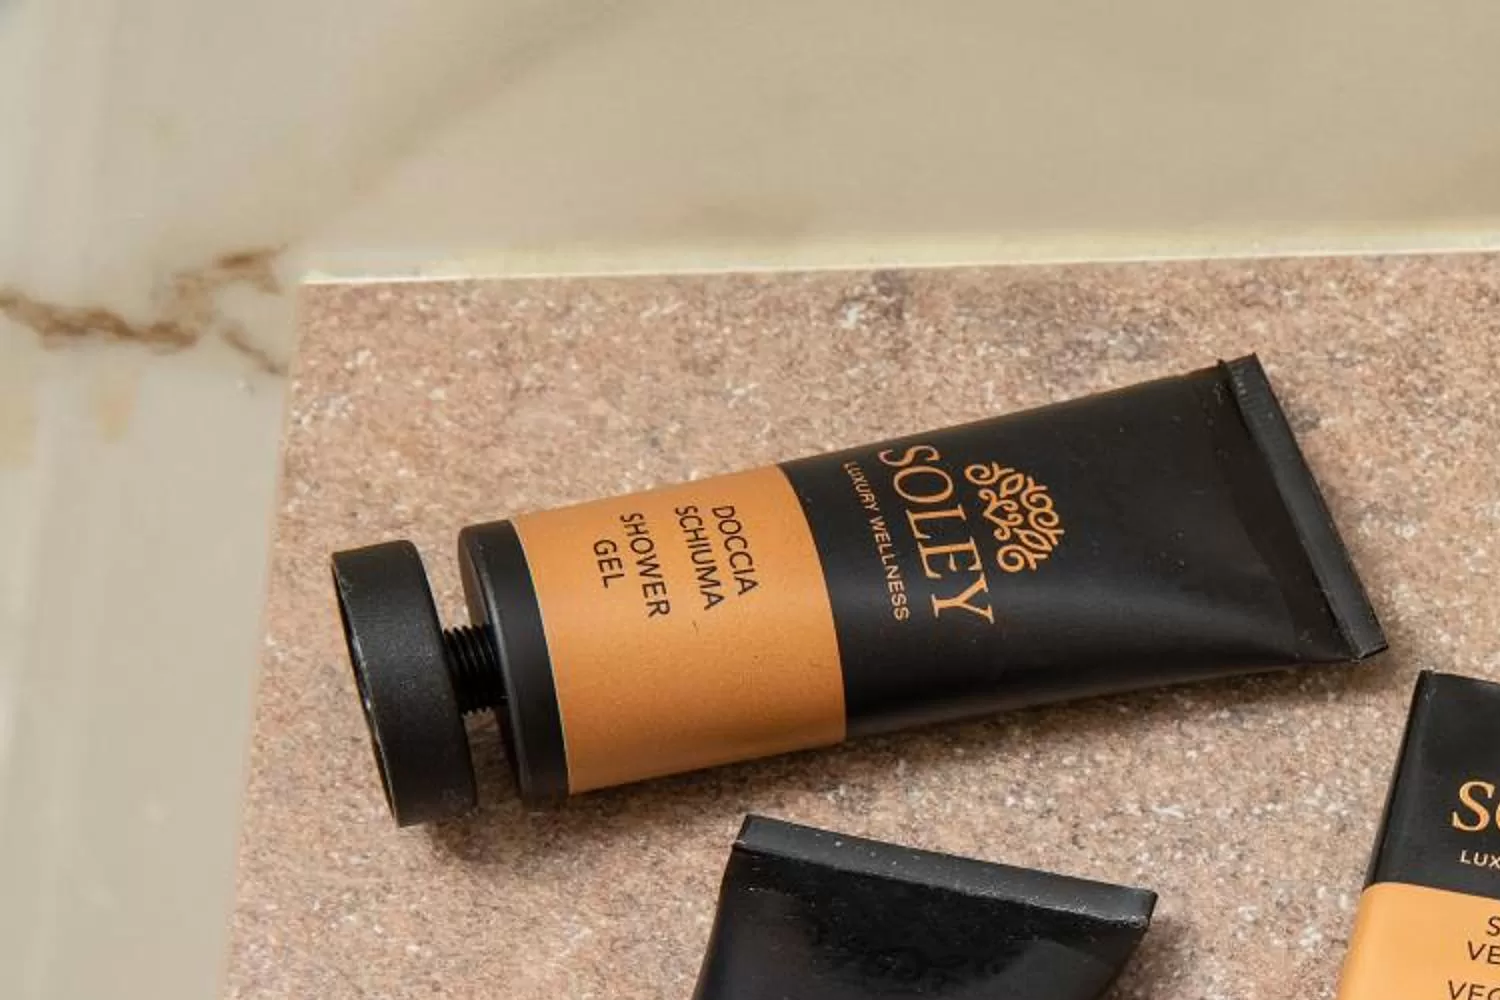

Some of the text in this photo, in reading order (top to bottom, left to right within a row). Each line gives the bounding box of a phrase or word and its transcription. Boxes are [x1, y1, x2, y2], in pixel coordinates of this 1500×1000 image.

[593, 540, 625, 589] GEL
[619, 512, 671, 618] SHOWER
[674, 504, 725, 610] SCHIUMA
[711, 504, 759, 597] DOCCIA
[842, 461, 909, 621] LUXURY WELLNESS
[879, 445, 995, 624] SOLEY
